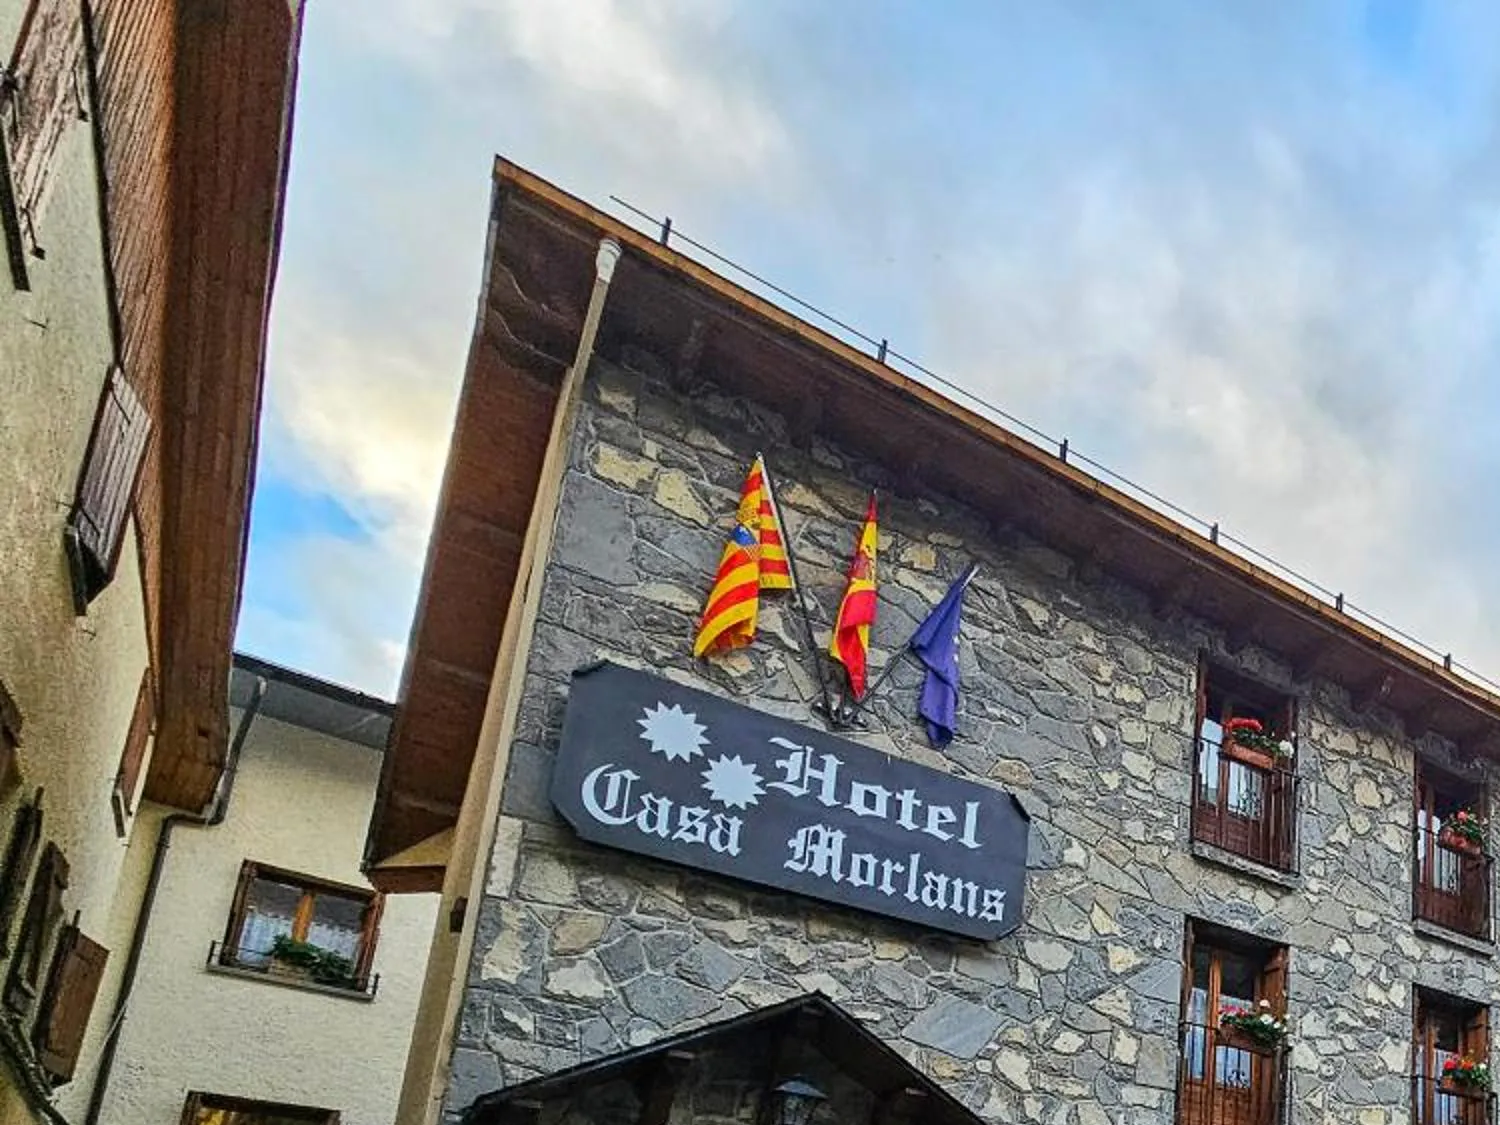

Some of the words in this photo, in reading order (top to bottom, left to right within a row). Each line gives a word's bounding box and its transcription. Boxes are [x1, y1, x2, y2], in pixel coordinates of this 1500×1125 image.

[581, 763, 743, 857] Casa
[783, 822, 1007, 924] Morlans
[766, 736, 983, 850] Hotel
